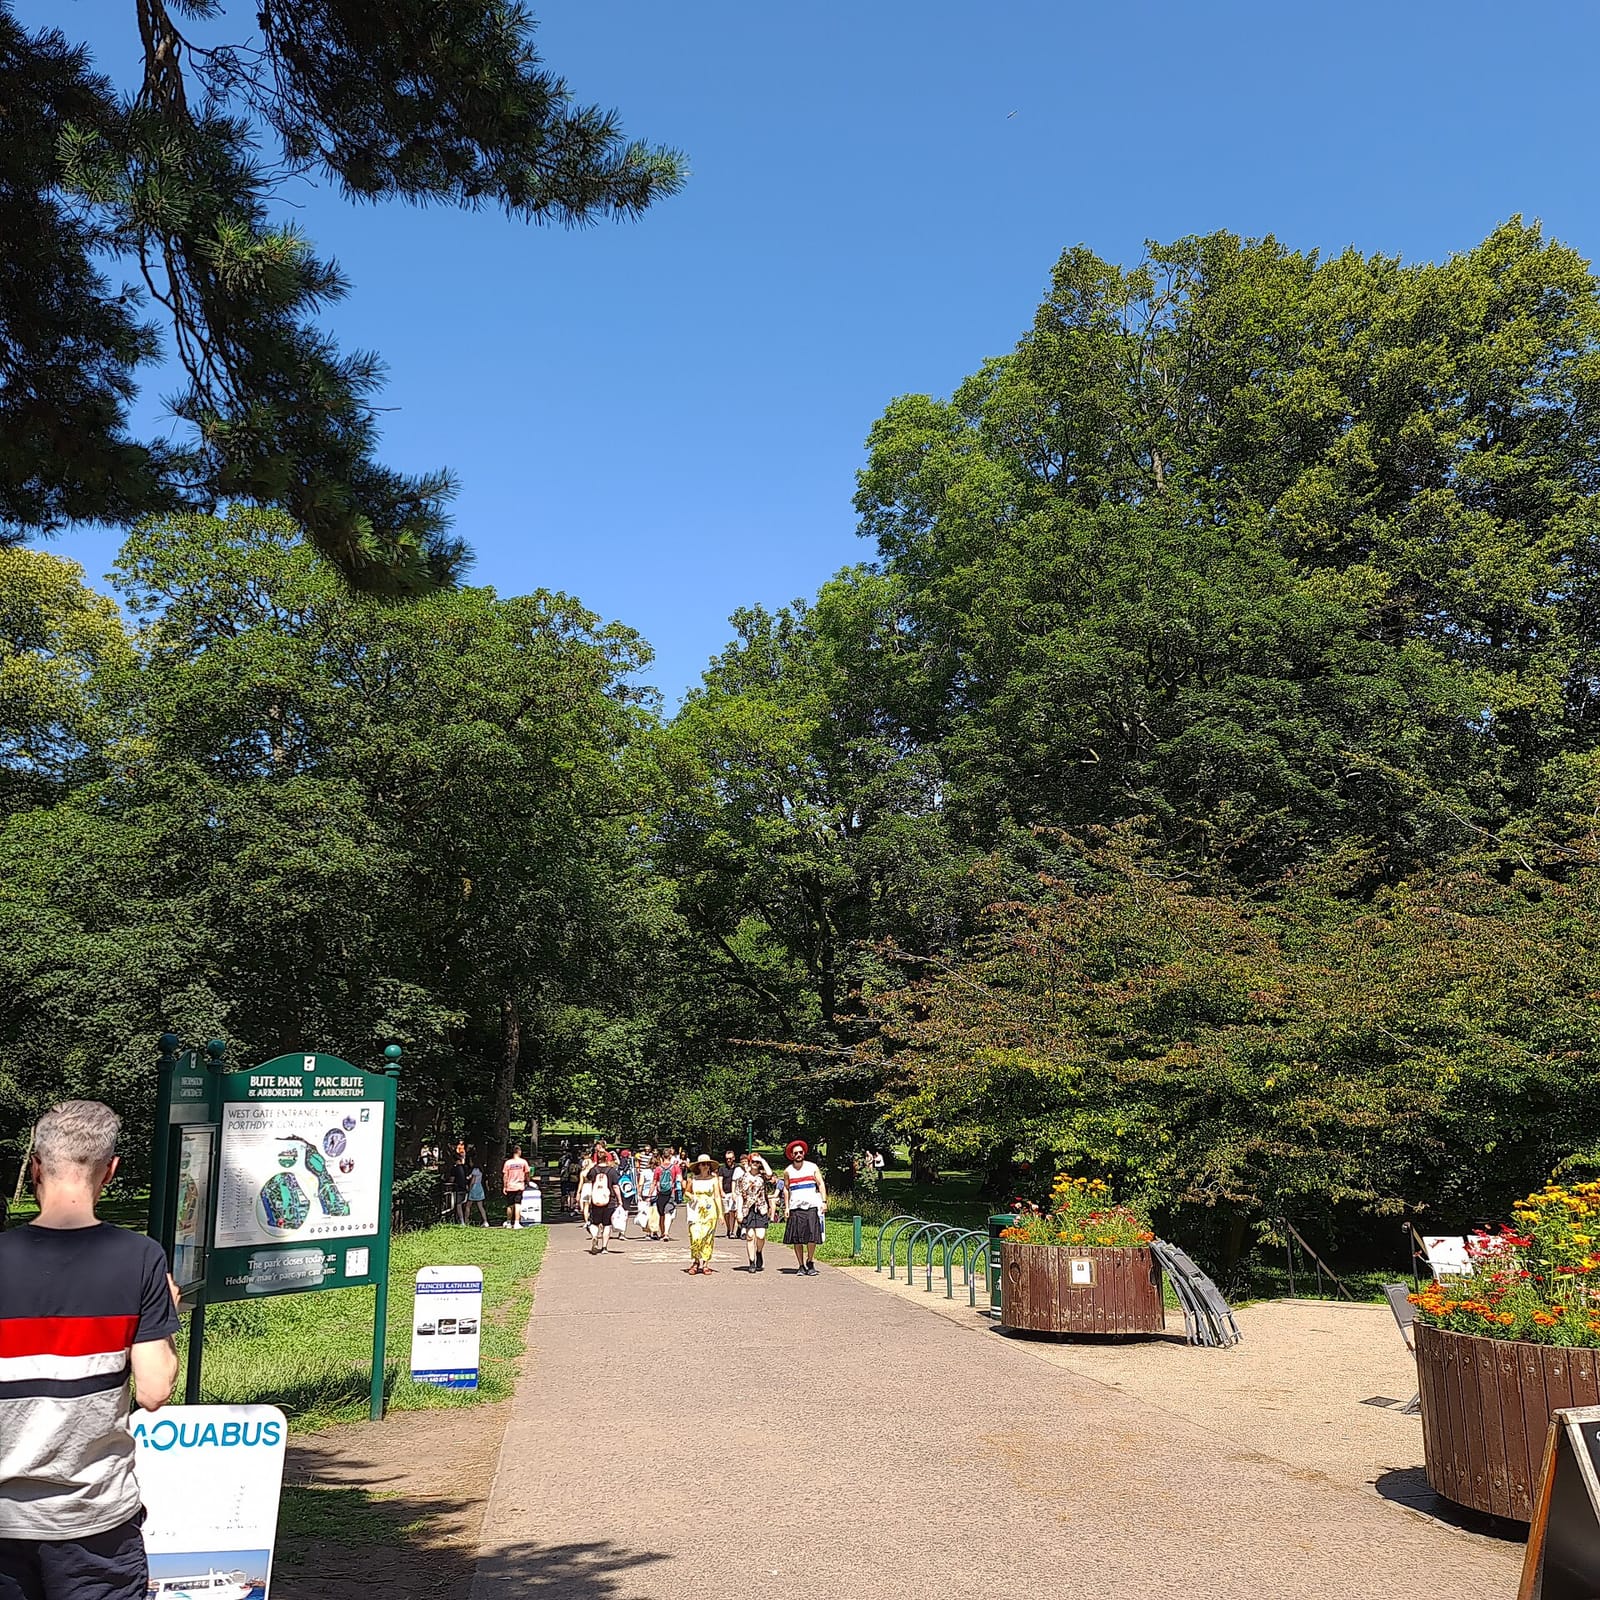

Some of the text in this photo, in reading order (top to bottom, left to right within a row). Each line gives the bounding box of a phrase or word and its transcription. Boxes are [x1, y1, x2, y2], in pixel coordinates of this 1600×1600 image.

[250, 1076, 302, 1087] BUTE PARK
[315, 1076, 364, 1087] PARC BUTE
[257, 1088, 303, 1097] ARBORETUM
[321, 1088, 364, 1097] ARBORETUM
[228, 1109, 250, 1119] WEST
[252, 1109, 273, 1118] GATE
[247, 1260, 263, 1270] The
[263, 1257, 281, 1272] park
[282, 1256, 304, 1266] closes
[305, 1254, 326, 1265] today
[279, 1271, 296, 1281] parc
[296, 1271, 306, 1279] yn
[133, 1420, 281, 1451] AQUABUS
